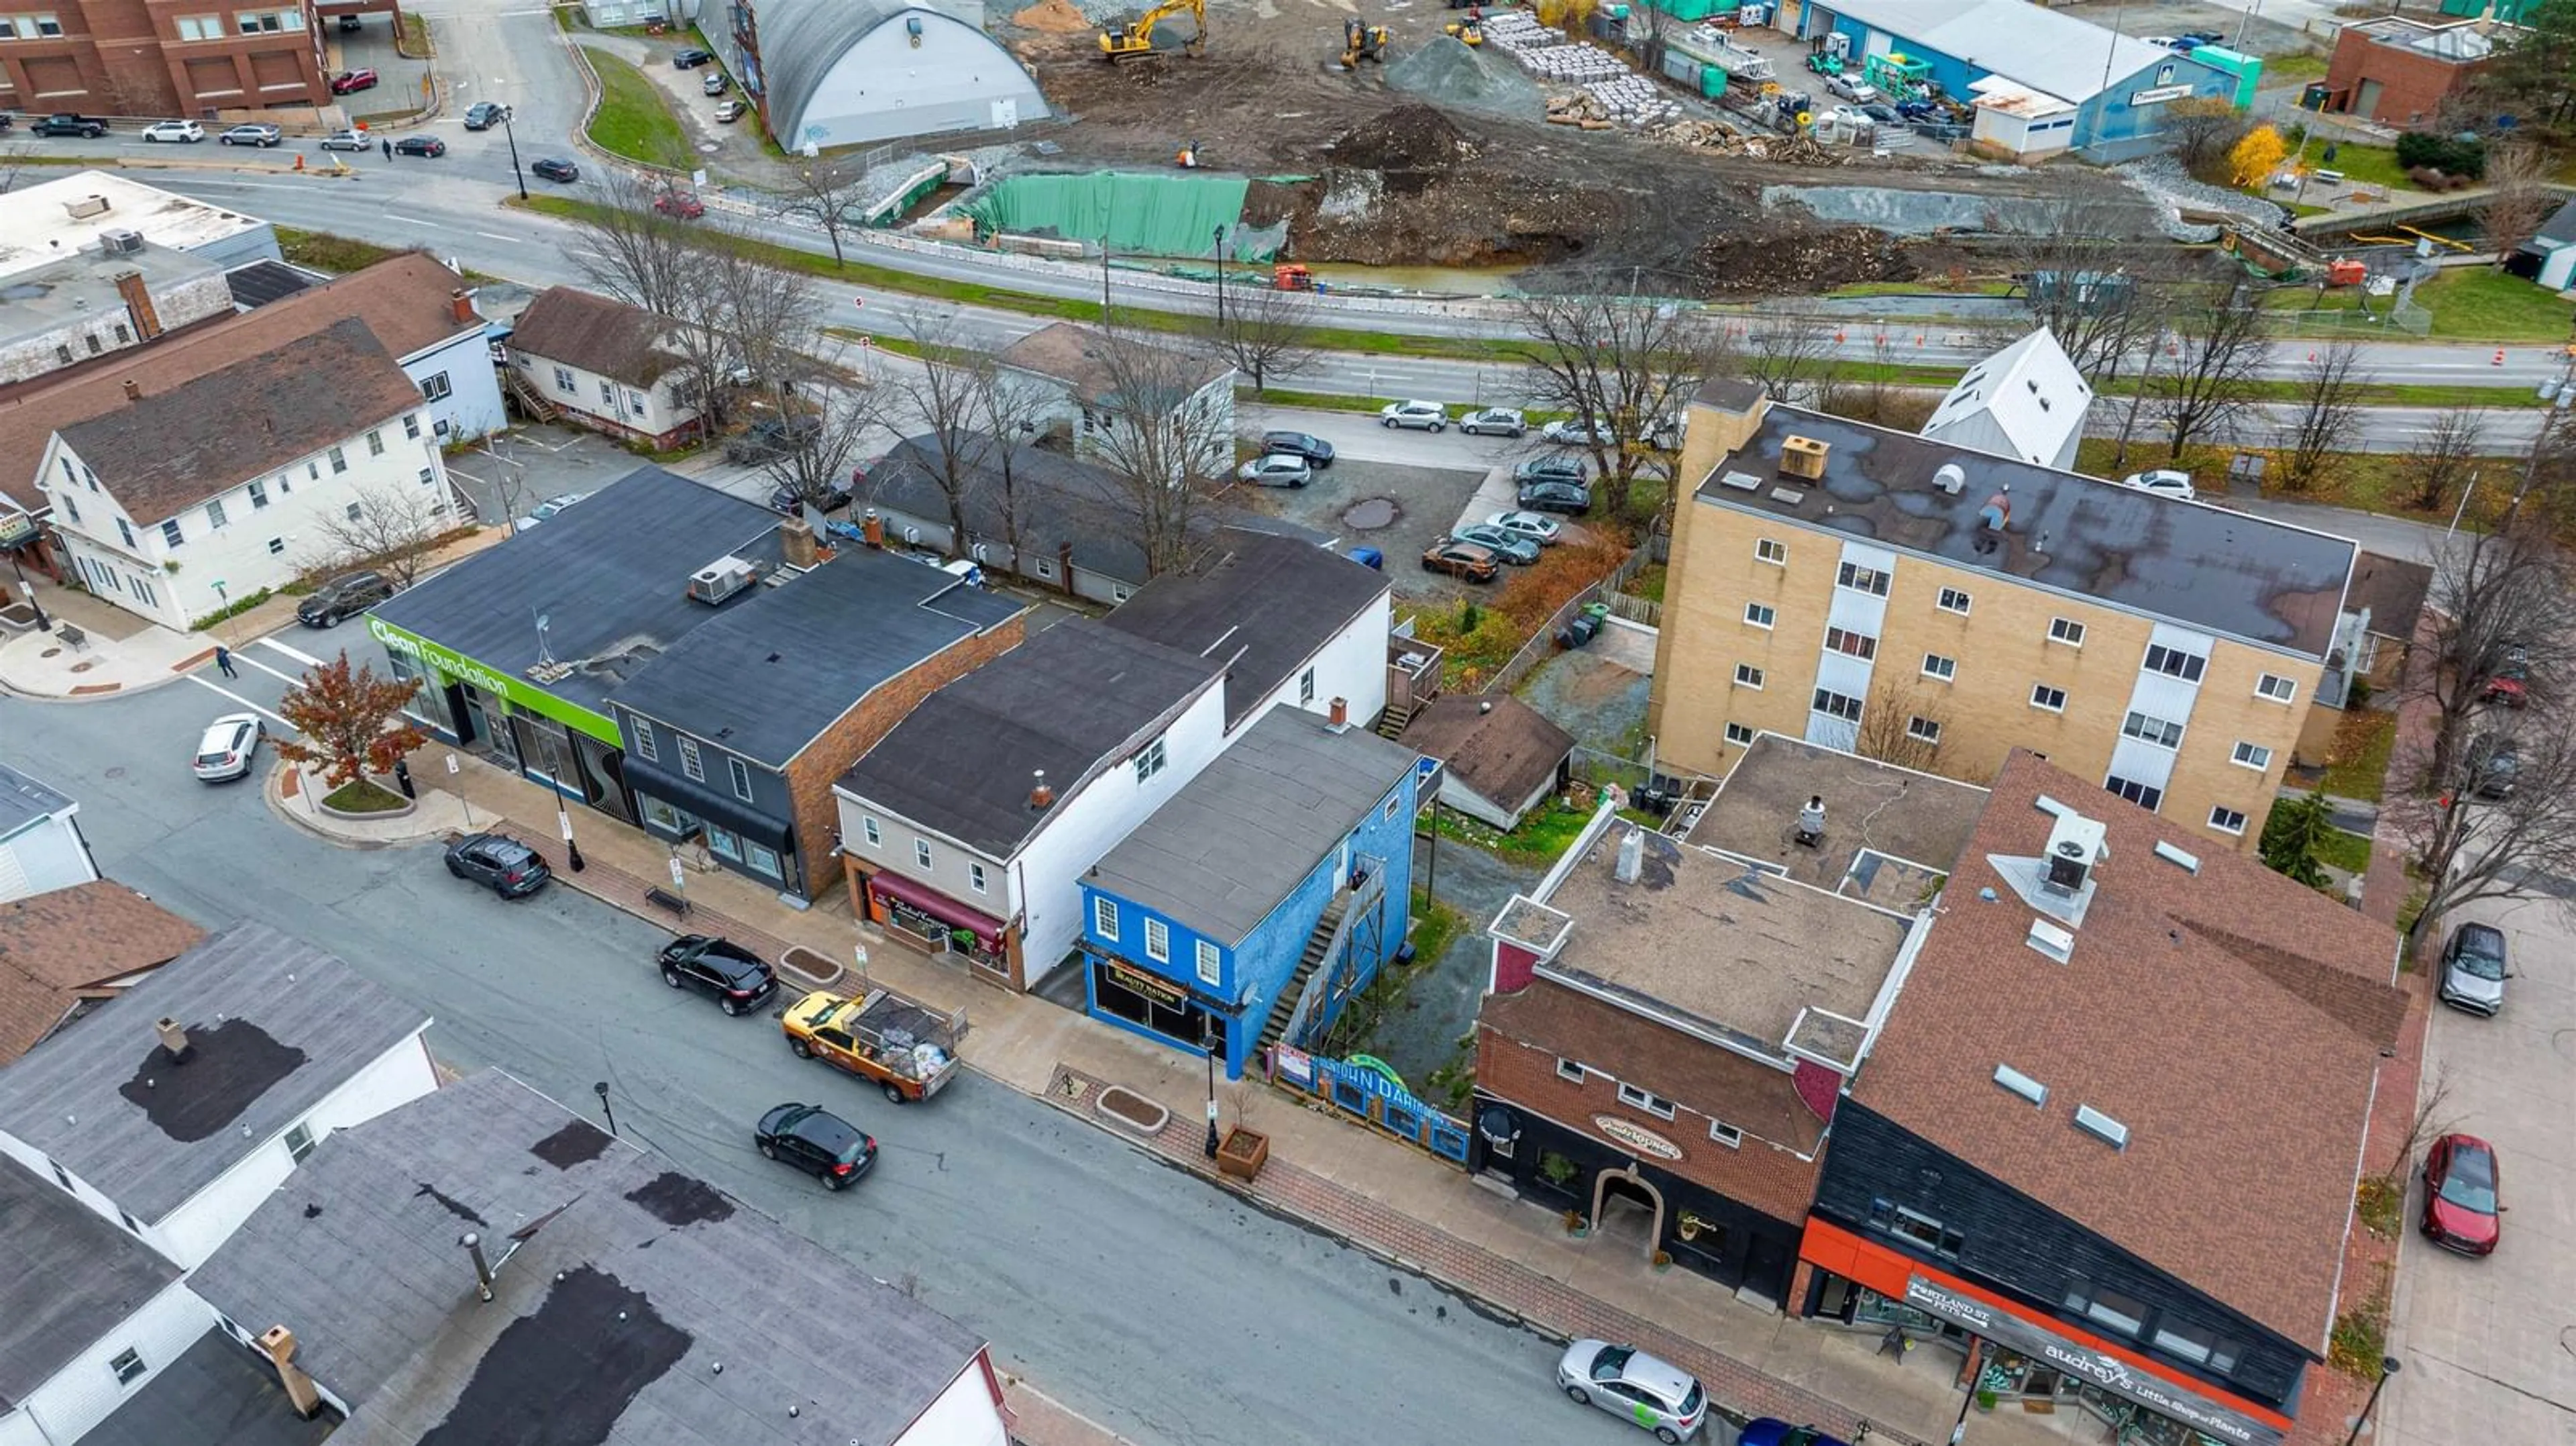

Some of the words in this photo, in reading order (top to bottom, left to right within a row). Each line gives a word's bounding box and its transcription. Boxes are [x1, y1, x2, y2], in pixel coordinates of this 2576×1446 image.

[372, 620, 420, 658] Clean
[419, 641, 508, 696] Foundation
[1379, 1078, 1444, 1124] DARTM
[1912, 1282, 1974, 1314] PORTLAND
[2045, 1345, 2134, 1390] audrey's
